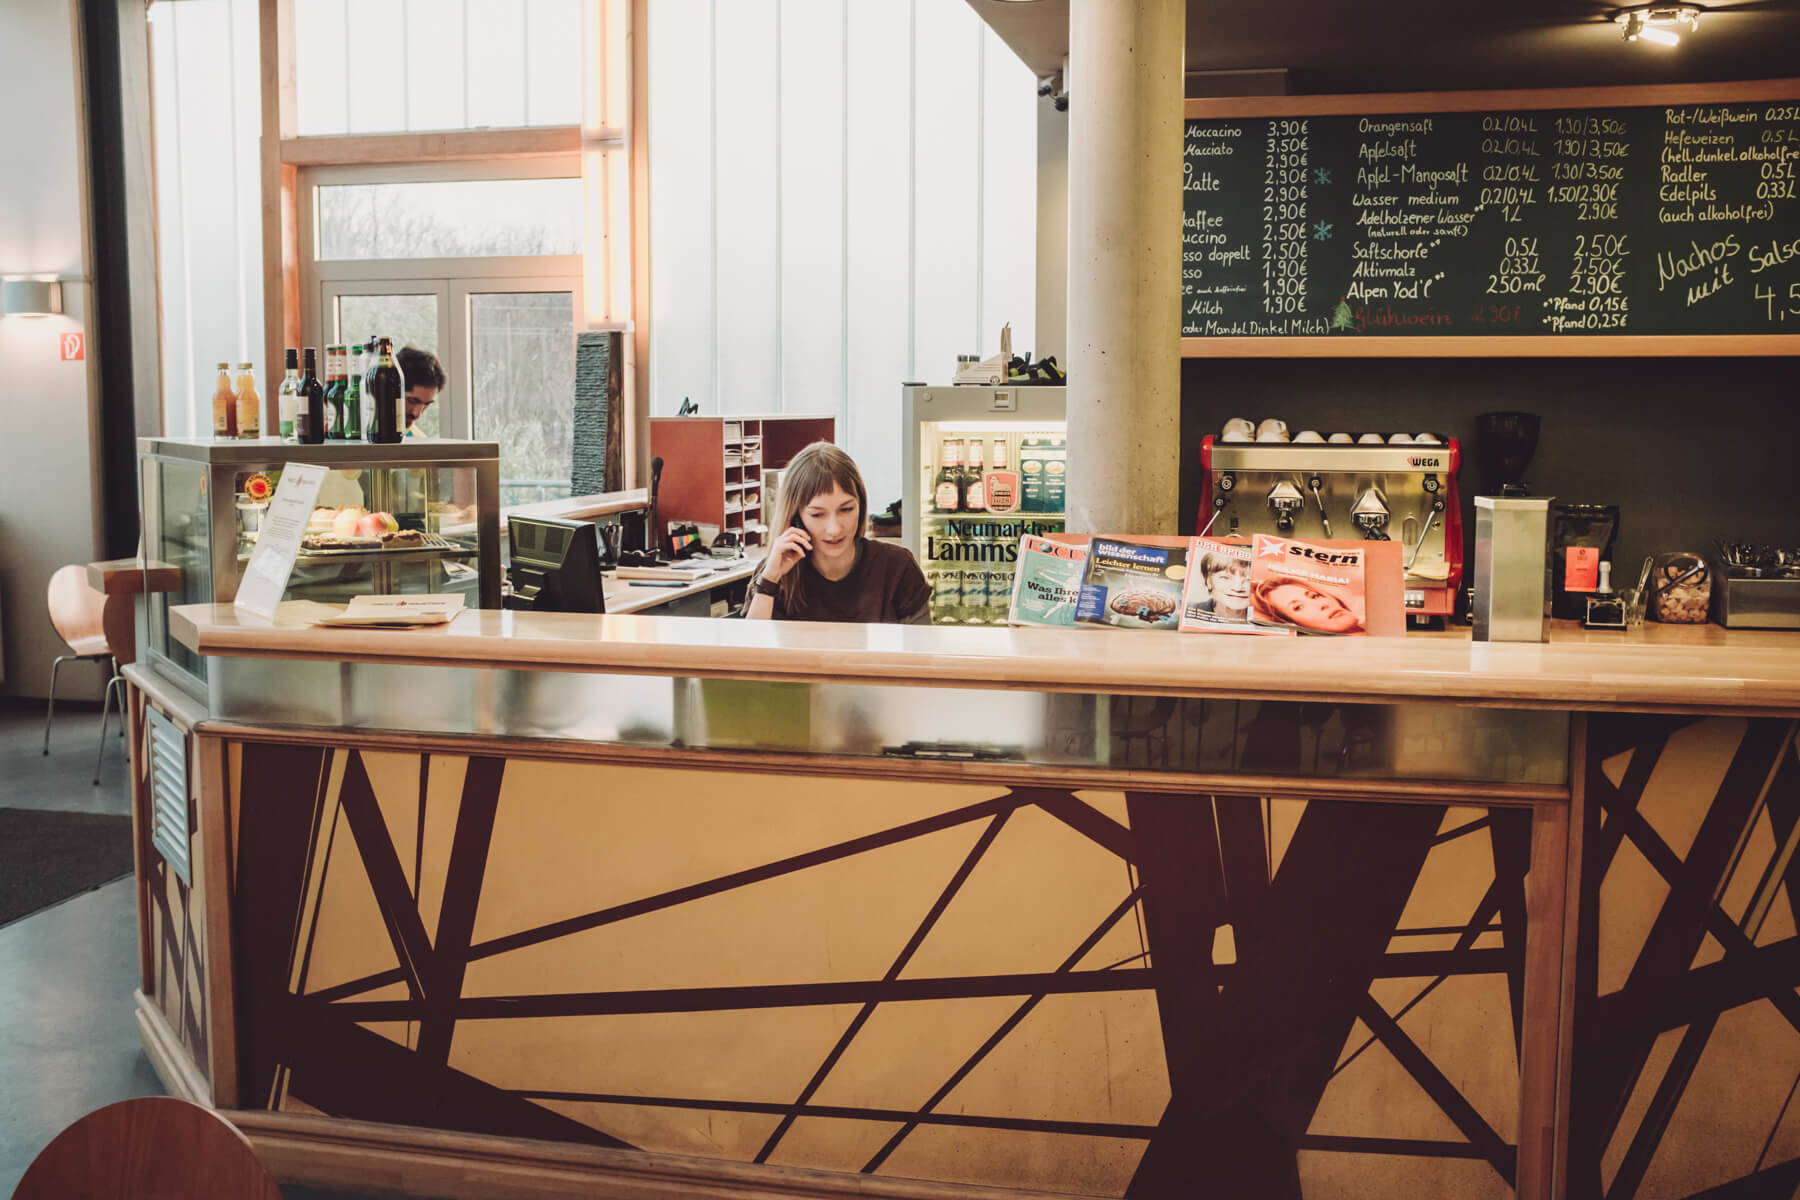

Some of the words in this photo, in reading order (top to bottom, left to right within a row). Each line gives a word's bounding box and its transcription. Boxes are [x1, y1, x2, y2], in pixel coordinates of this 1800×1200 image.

[1184, 124, 1242, 137] Moccacino
[1266, 120, 1309, 137] 3,90€
[1359, 118, 1433, 137] Orangensaft
[1183, 142, 1233, 156] Macciato
[1266, 137, 1309, 153] 3,50€
[1664, 129, 1734, 151] Hefeweizen
[1266, 153, 1308, 169] 2,90€
[1359, 139, 1417, 165] Apfelsaft
[1183, 172, 1220, 191] Latte
[1264, 168, 1308, 185] 2,90€
[1660, 164, 1708, 183] Radler
[1264, 185, 1308, 203] 2,90€
[1352, 193, 1399, 206] Wasser
[1408, 191, 1459, 206] medium
[1660, 182, 1717, 206] Edelpils
[1263, 202, 1307, 222] 2,90€
[1356, 208, 1435, 225] Adelholzener
[1659, 205, 1694, 223] (auch
[1698, 200, 1774, 224] alkoholfrei)
[1263, 222, 1307, 241] 2,50€
[1409, 226, 1430, 235] oder
[1433, 225, 1468, 237] sanft)
[1208, 244, 1251, 267] doppelt
[1262, 241, 1308, 260] 2,50€
[1658, 234, 1741, 291] Nachos
[1262, 259, 1308, 278] 1,90€
[1352, 261, 1416, 278] Aktivmalz
[1262, 278, 1308, 296] 1,90€
[1346, 280, 1388, 304] Alpen
[1687, 263, 1734, 307] mit
[1187, 300, 1223, 315] Milch
[1263, 296, 1307, 314] 1,90€
[1589, 296, 1629, 312] 0,15€
[1205, 320, 1247, 335] Mandel
[1250, 320, 1288, 335] Dinkel
[1291, 317, 1330, 335] Milch)
[1587, 313, 1628, 329] 0,25€
[1412, 457, 1440, 467] WEGA
[948, 520, 1056, 537] Neumarkter
[1099, 543, 1119, 552] bild
[1119, 547, 1136, 555] der
[1289, 546, 1358, 564] stern
[1133, 563, 1160, 573] lernen
[1027, 581, 1052, 593] Was
